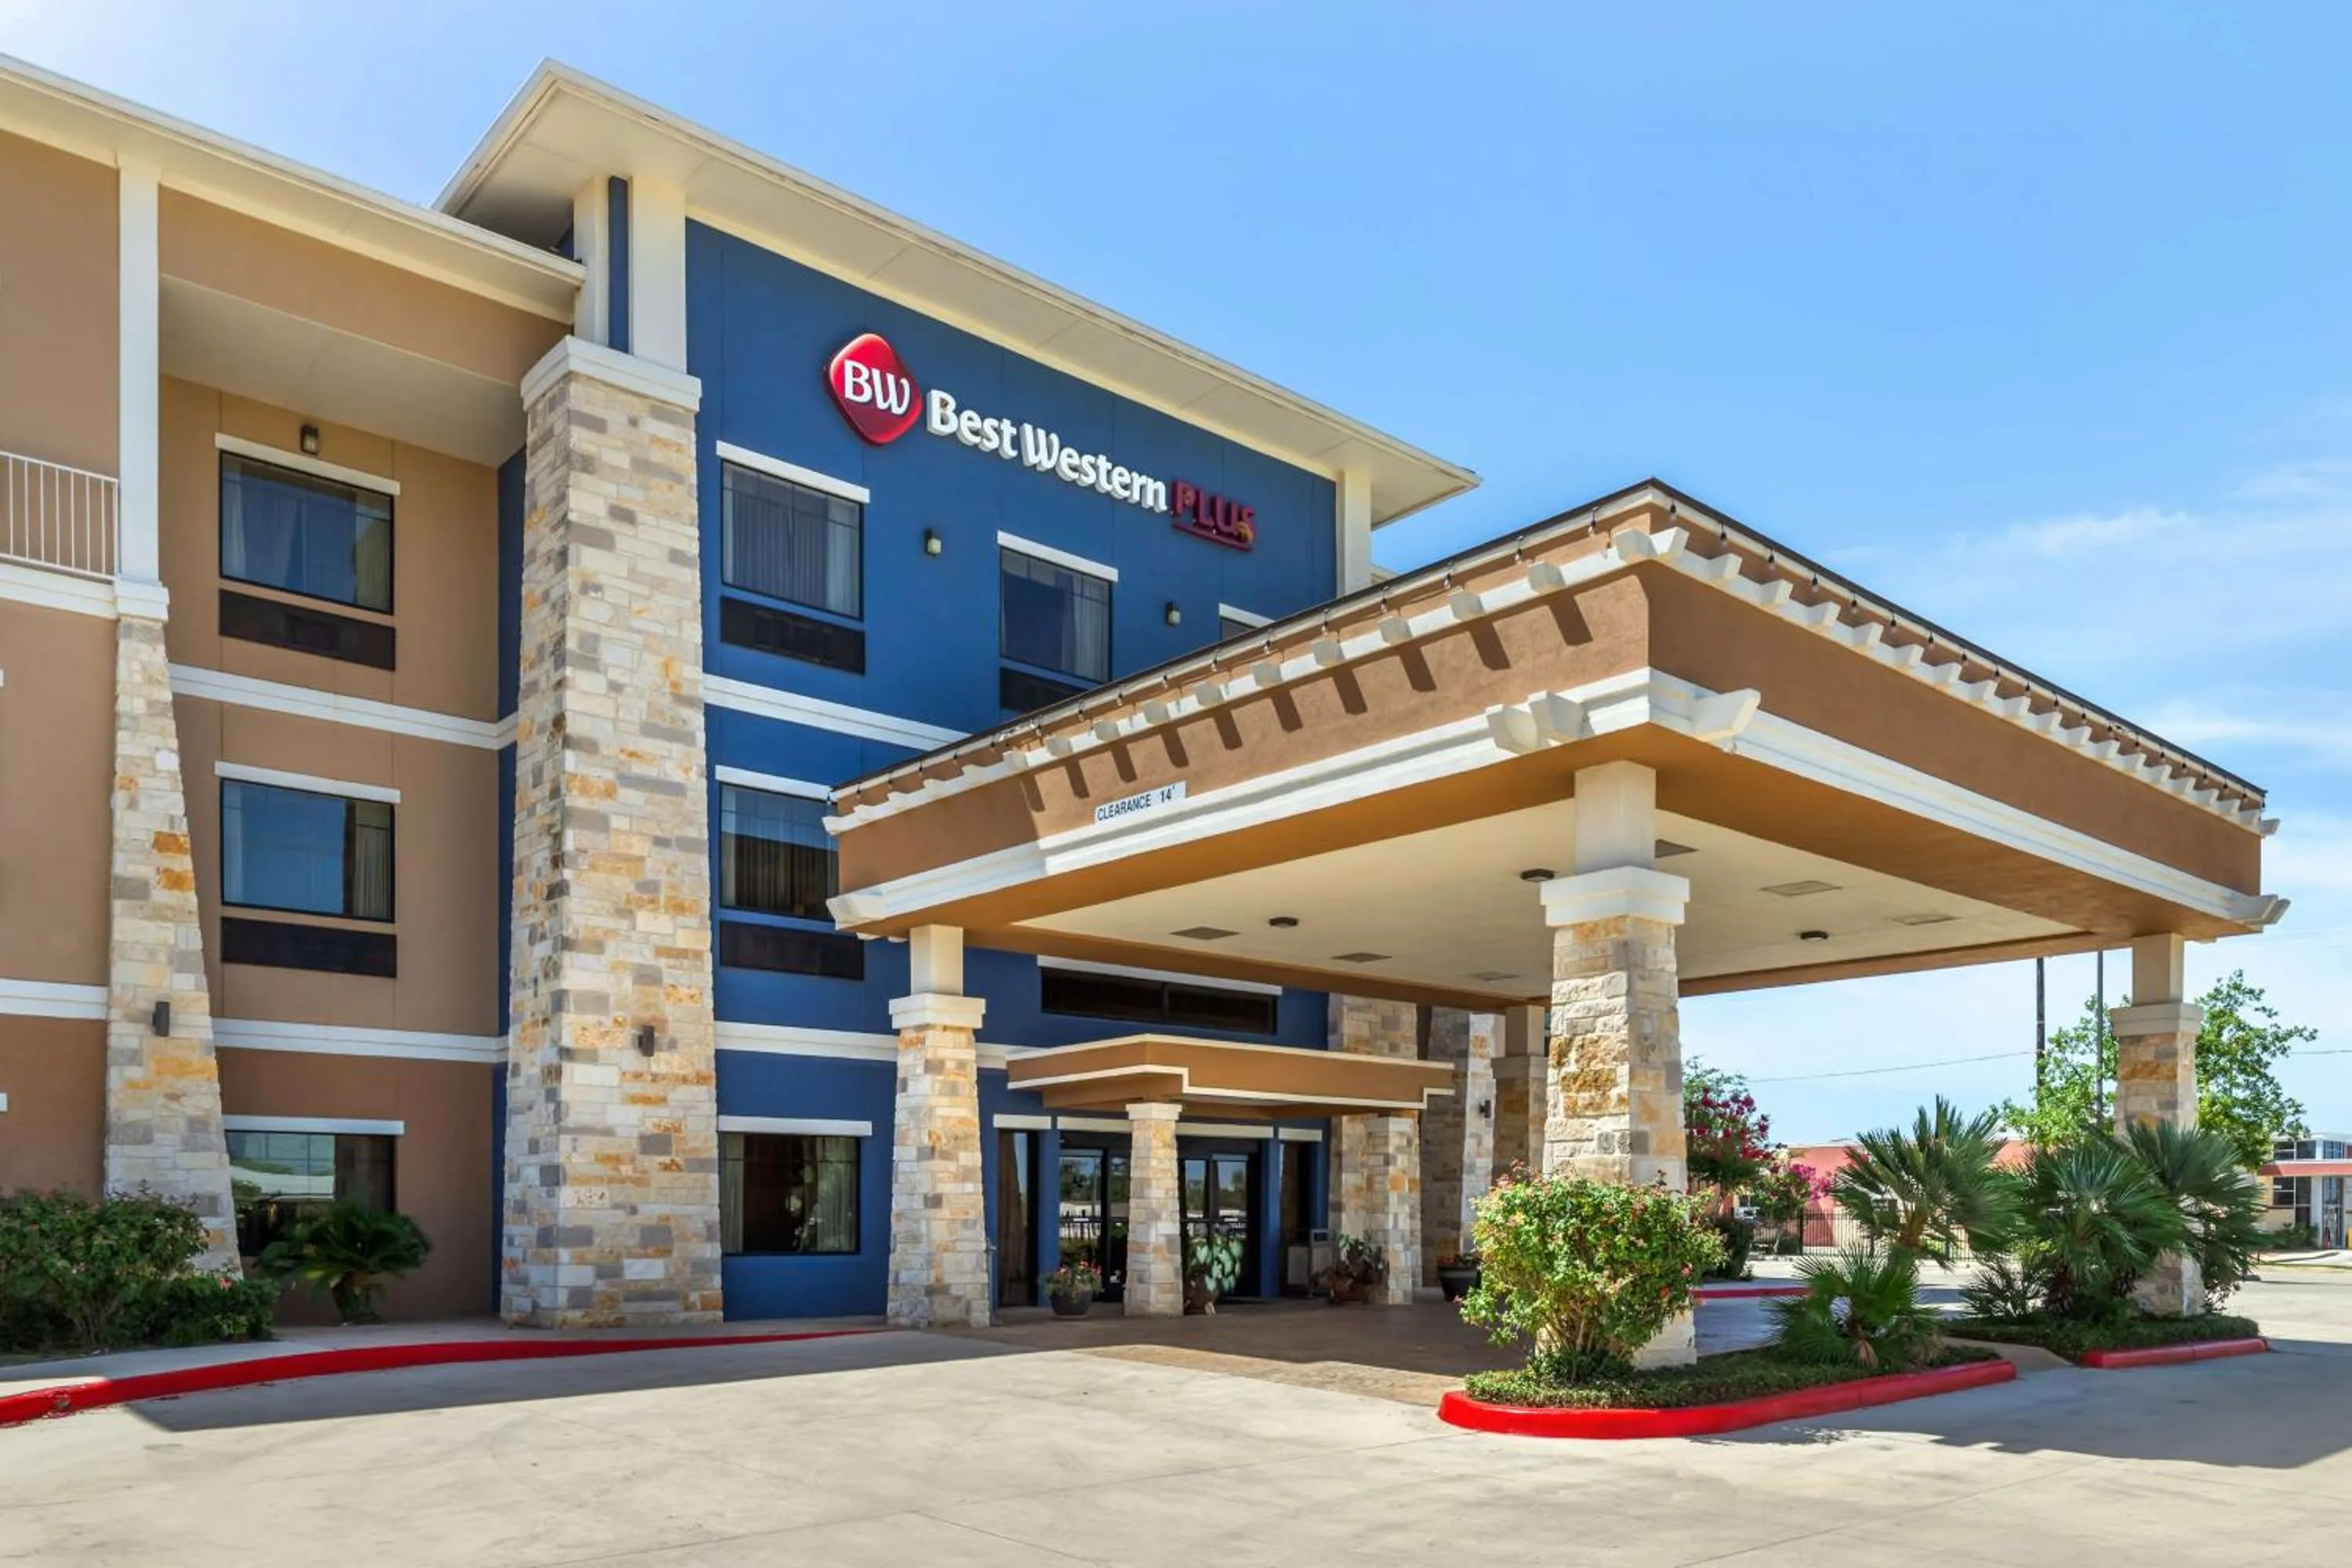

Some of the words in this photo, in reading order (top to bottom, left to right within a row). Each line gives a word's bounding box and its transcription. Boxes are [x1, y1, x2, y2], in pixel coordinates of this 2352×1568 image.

[843, 360, 911, 416] BW
[927, 389, 1018, 459] Best
[1020, 422, 1168, 513] Western
[1172, 479, 1255, 543] PLUS
[1098, 793, 1152, 821] CLEARANCE
